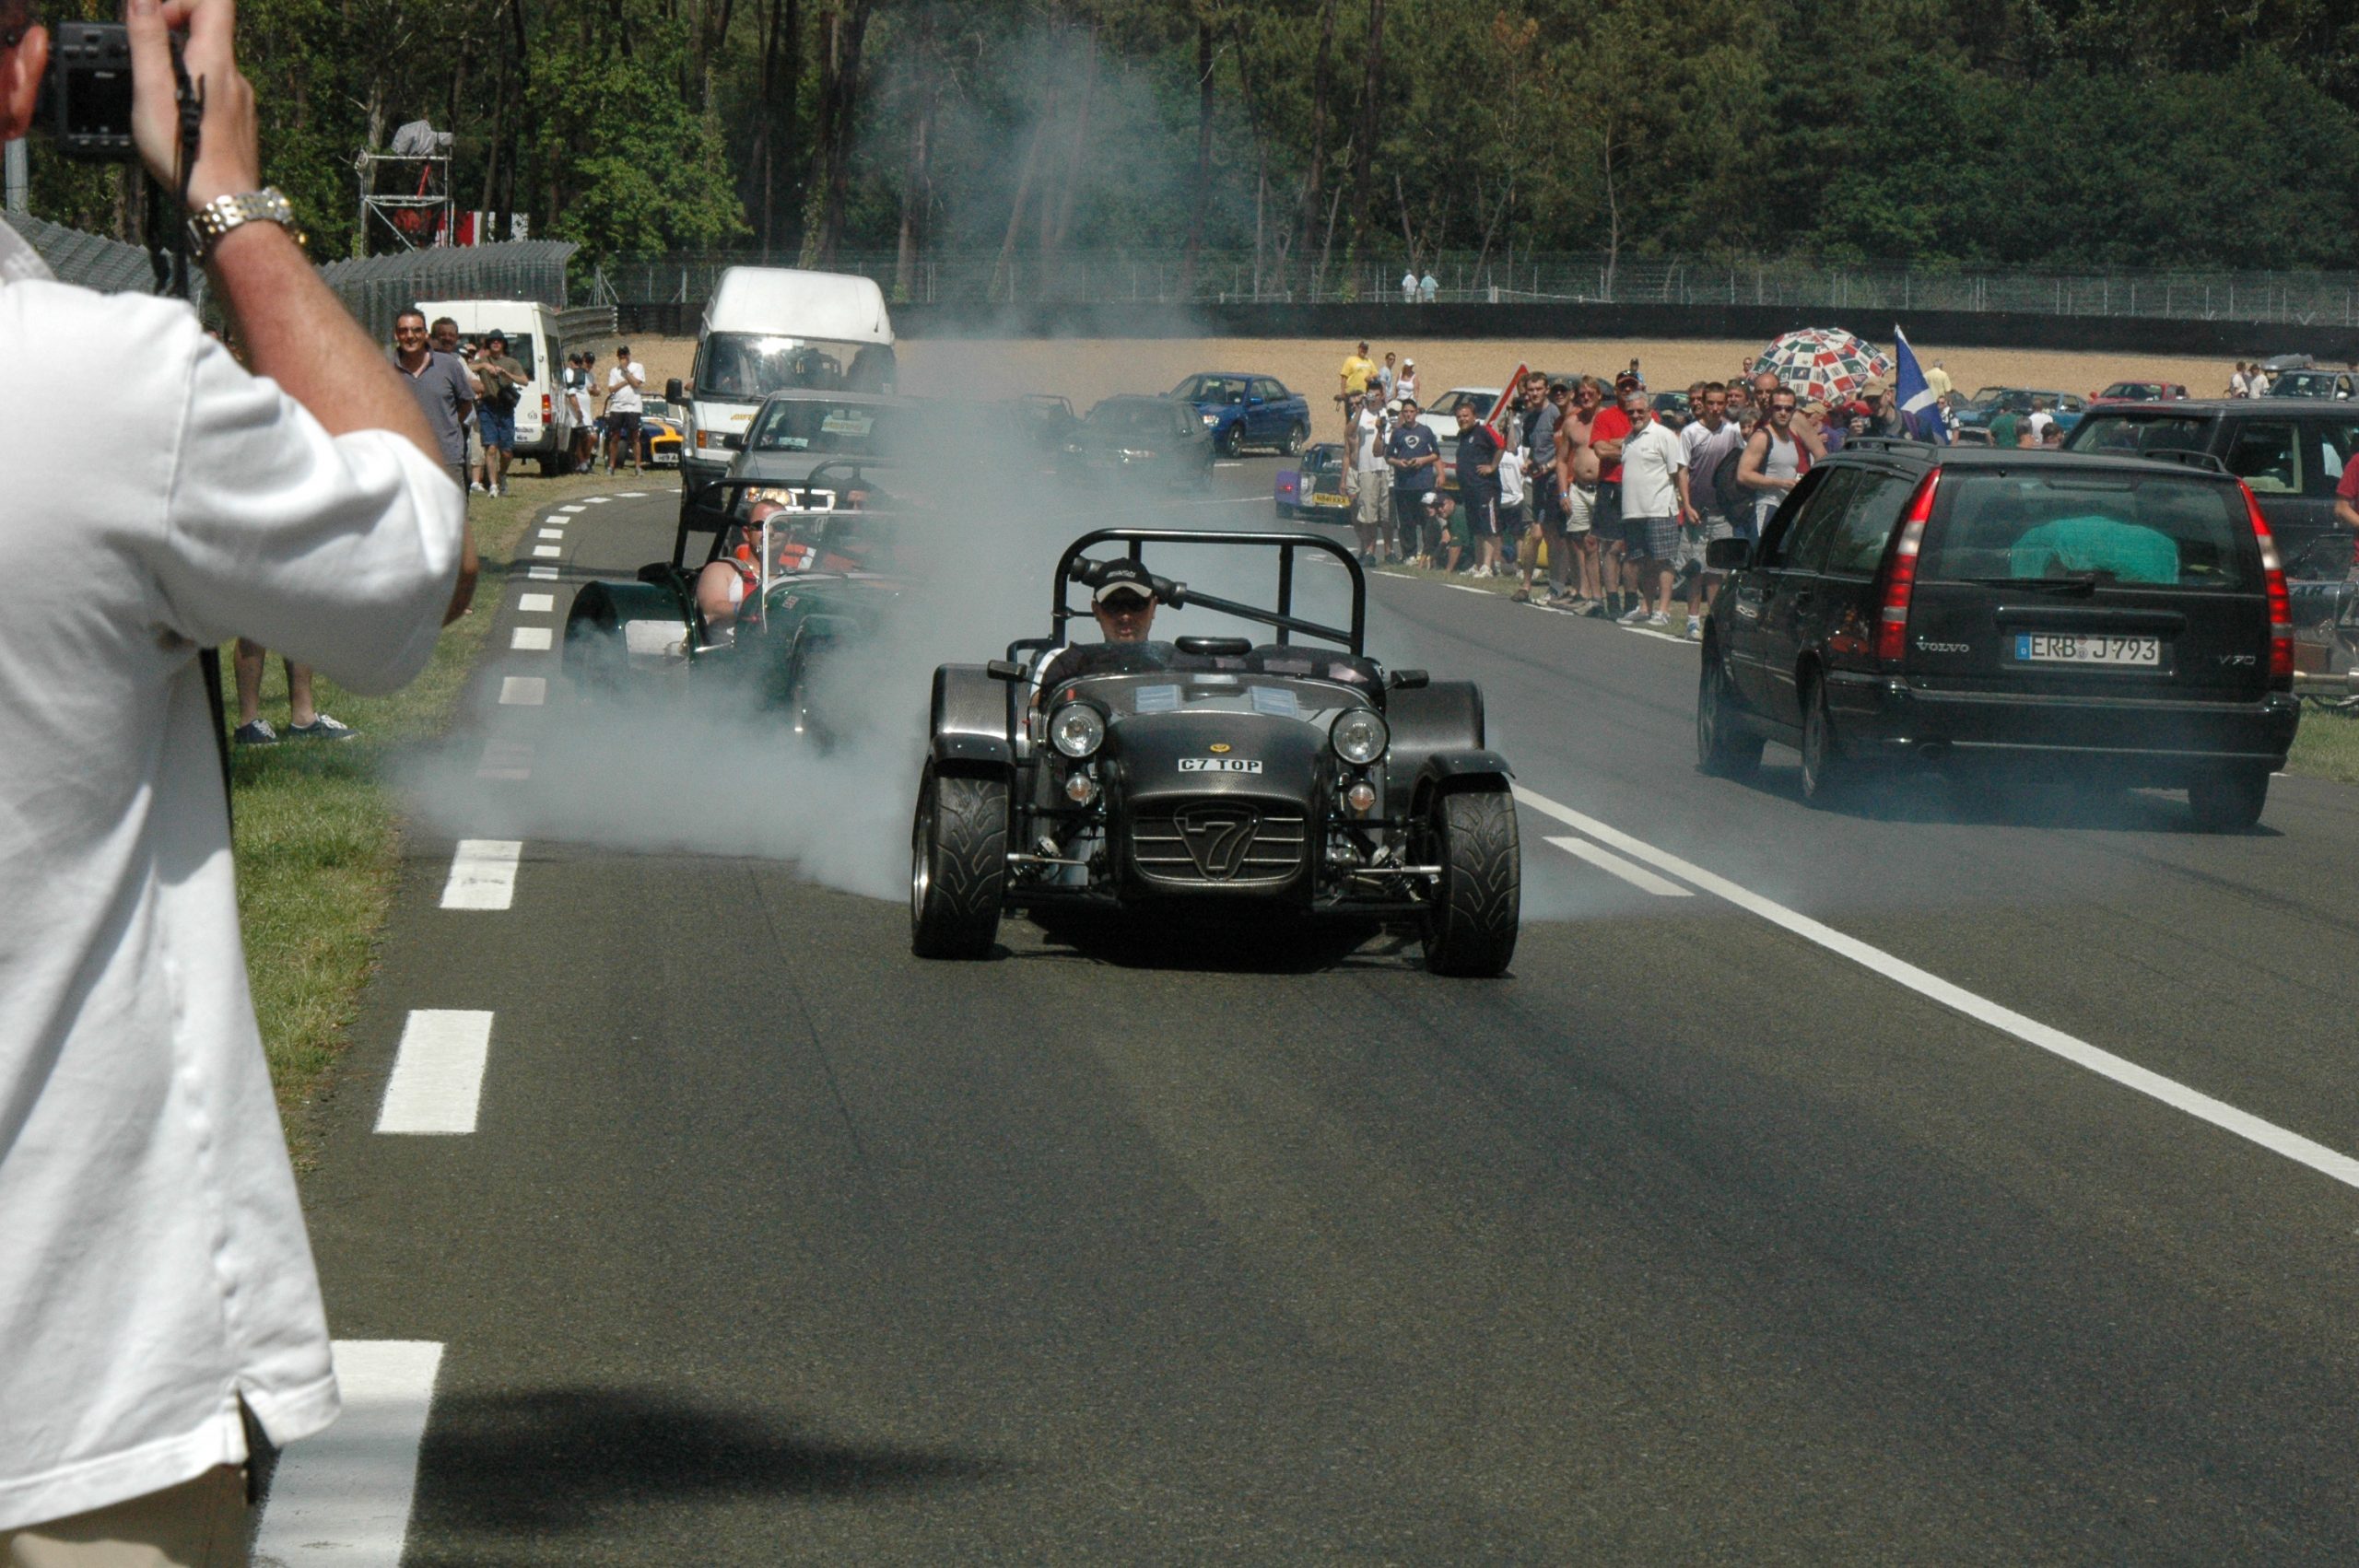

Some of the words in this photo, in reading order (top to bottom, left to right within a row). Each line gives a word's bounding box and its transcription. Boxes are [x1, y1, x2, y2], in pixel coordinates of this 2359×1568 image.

[1916, 641, 1970, 653] VOLVO
[2031, 635, 2076, 659] ERB
[2219, 654, 2257, 665] V70
[1180, 759, 1209, 770] C7
[1215, 759, 1260, 772] TOP
[1185, 809, 1251, 870] 7
